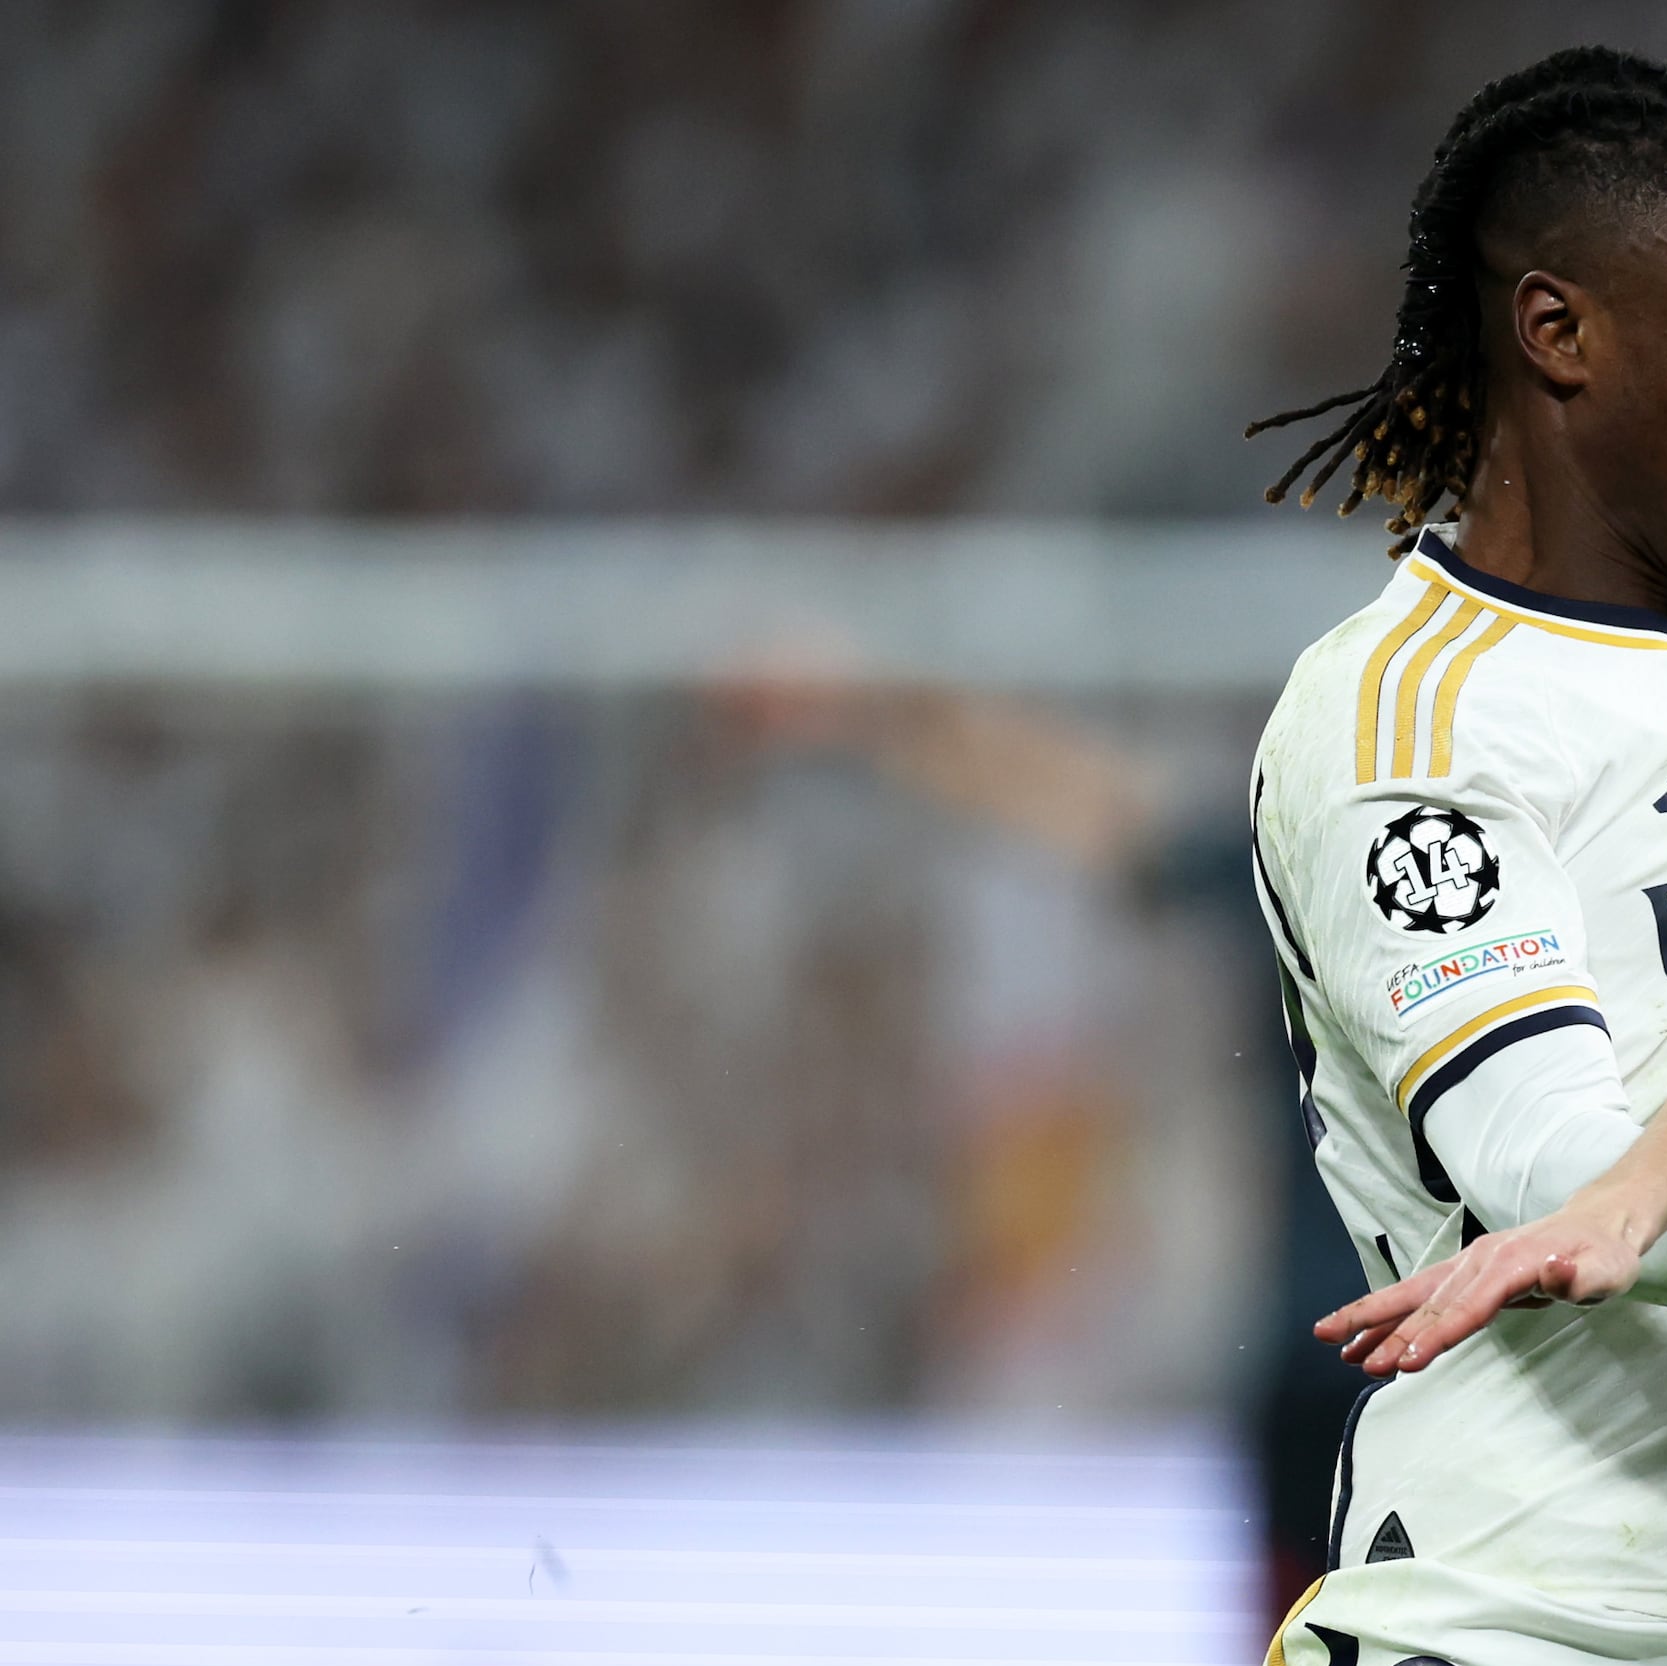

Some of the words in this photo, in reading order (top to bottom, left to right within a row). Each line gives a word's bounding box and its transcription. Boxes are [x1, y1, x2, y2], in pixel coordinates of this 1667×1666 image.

[1393, 839, 1470, 906] 14
[1386, 963, 1419, 991] UEFA
[1391, 935, 1559, 1010] FOUNDATION
